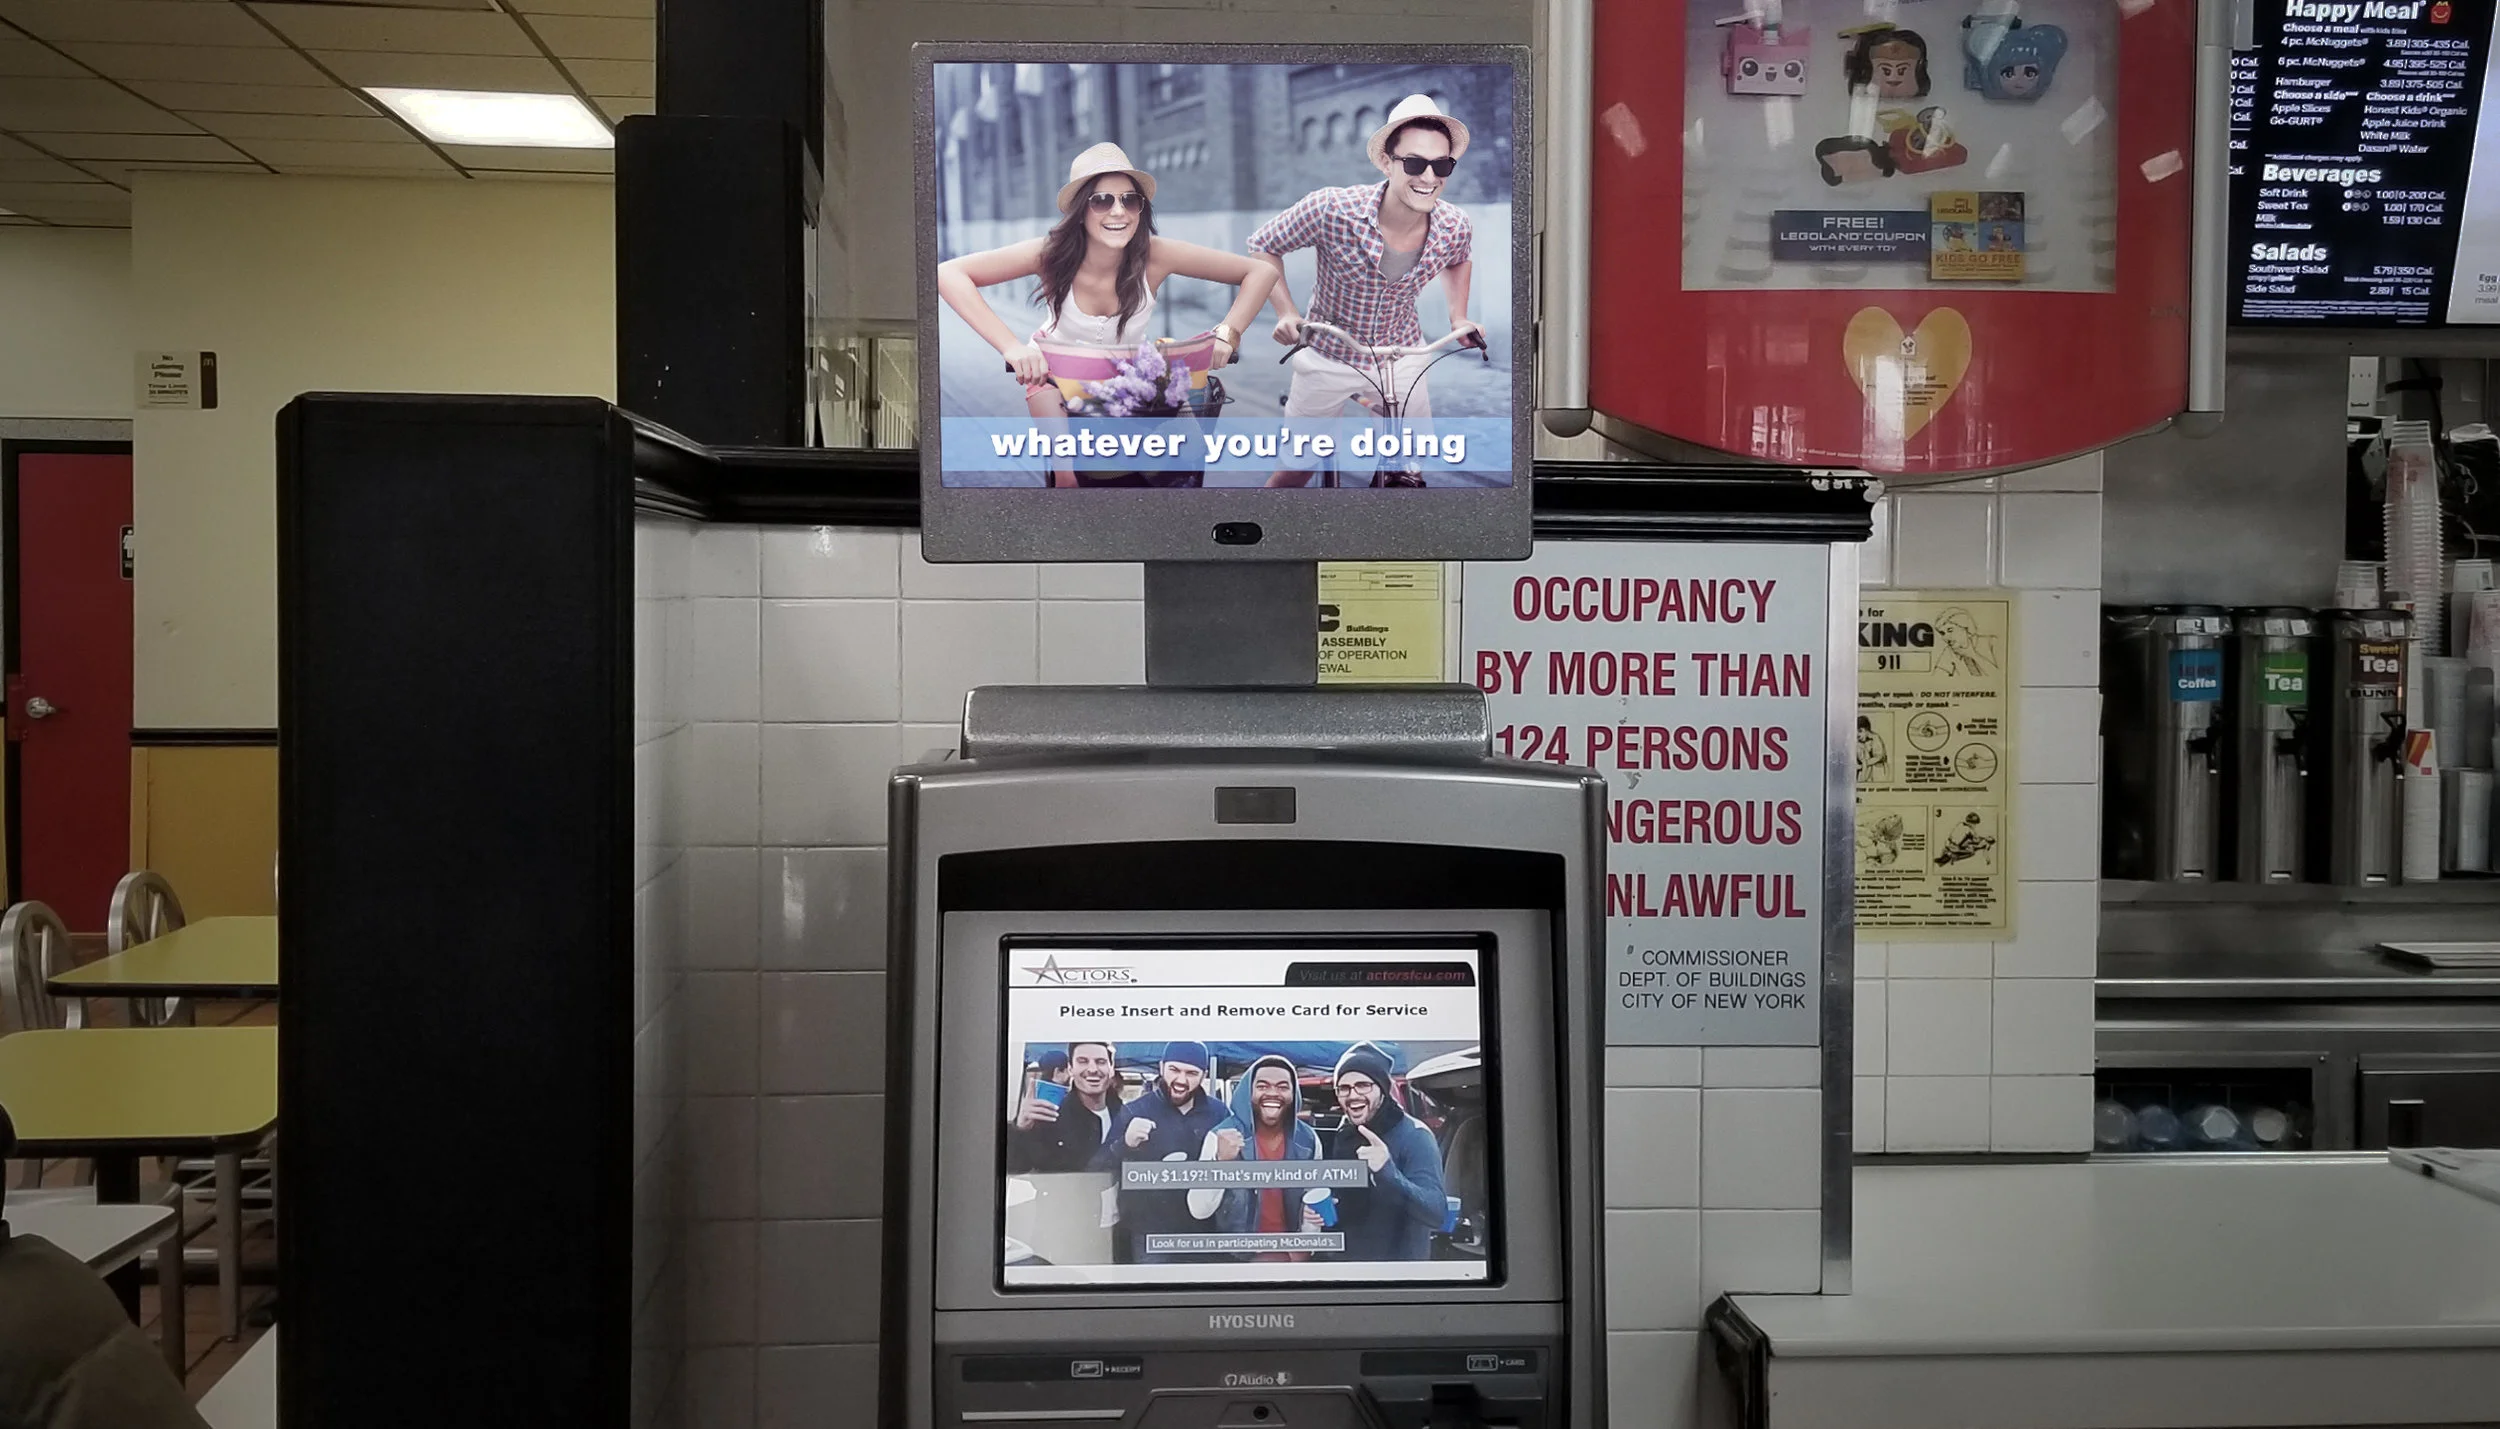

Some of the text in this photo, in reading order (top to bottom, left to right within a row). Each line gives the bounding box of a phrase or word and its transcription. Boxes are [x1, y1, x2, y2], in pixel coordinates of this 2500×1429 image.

[2286, 0, 2360, 23] Happy
[2283, 24, 2323, 32] Choose
[2333, 24, 2359, 33] meal
[2281, 37, 2287, 45] 4
[2278, 57, 2285, 65] 6
[2275, 77, 2332, 88] Hamburger
[2273, 90, 2313, 100] Choose
[2366, 92, 2405, 101] Choose
[2271, 103, 2332, 114] Apple Slices
[2364, 105, 2399, 114] Honest
[2429, 106, 2468, 117] Organic
[2362, 118, 2446, 128] Apple Juice Drink
[2360, 131, 2411, 140] White Milk
[2399, 145, 2429, 153] Water
[2262, 163, 2382, 186] Beverages
[2259, 188, 2308, 198] Soft Drink
[2258, 201, 2309, 210] Sweet Tea
[1823, 217, 1884, 229] FREE!
[2255, 214, 2277, 222] Milk
[1863, 232, 1926, 241] COUPON
[2251, 243, 2328, 261] Salads
[1936, 254, 2020, 263] KIDS GO FREE
[2248, 264, 2329, 274] Southwest Salad
[2245, 285, 2296, 293] Side Salad
[991, 429, 1466, 464] whatever you're doing
[1513, 576, 1776, 623] OCCUPANCY
[1868, 607, 1884, 618] for
[1346, 625, 1389, 633] Buildings
[1321, 638, 1386, 647] ASSEMBLY
[1318, 650, 1407, 659] OF OPERATION
[2360, 644, 2399, 654] Sweet
[1878, 655, 1900, 670] 911
[2360, 656, 2398, 673] Tea
[1475, 651, 1811, 697] BY MORE THAN
[2178, 678, 2216, 689] Coffee
[2265, 674, 2302, 691] Tea
[1496, 725, 1788, 771] 124 PERSONS
[1936, 809, 1942, 817] 3
[1642, 950, 1788, 966] COMMISSIONER
[1300, 970, 1465, 981] Visit us at actorsfcu.com
[1619, 971, 1806, 988] DEPT. OF BUILDINGS
[1622, 993, 1806, 1009] CITY OF NEW YORK
[1060, 1004, 1428, 1017] Please Insert and Remove Card for Service
[1128, 1169, 1358, 1184] Only $1.19?! That's my kind of ATM!
[1152, 1238, 1174, 1248] Look
[1177, 1238, 1191, 1247] for
[1206, 1239, 1216, 1247] in
[1218, 1238, 1277, 1250] participating
[1209, 1314, 1294, 1328] HYOSUNG
[1239, 1375, 1274, 1385] Audio
